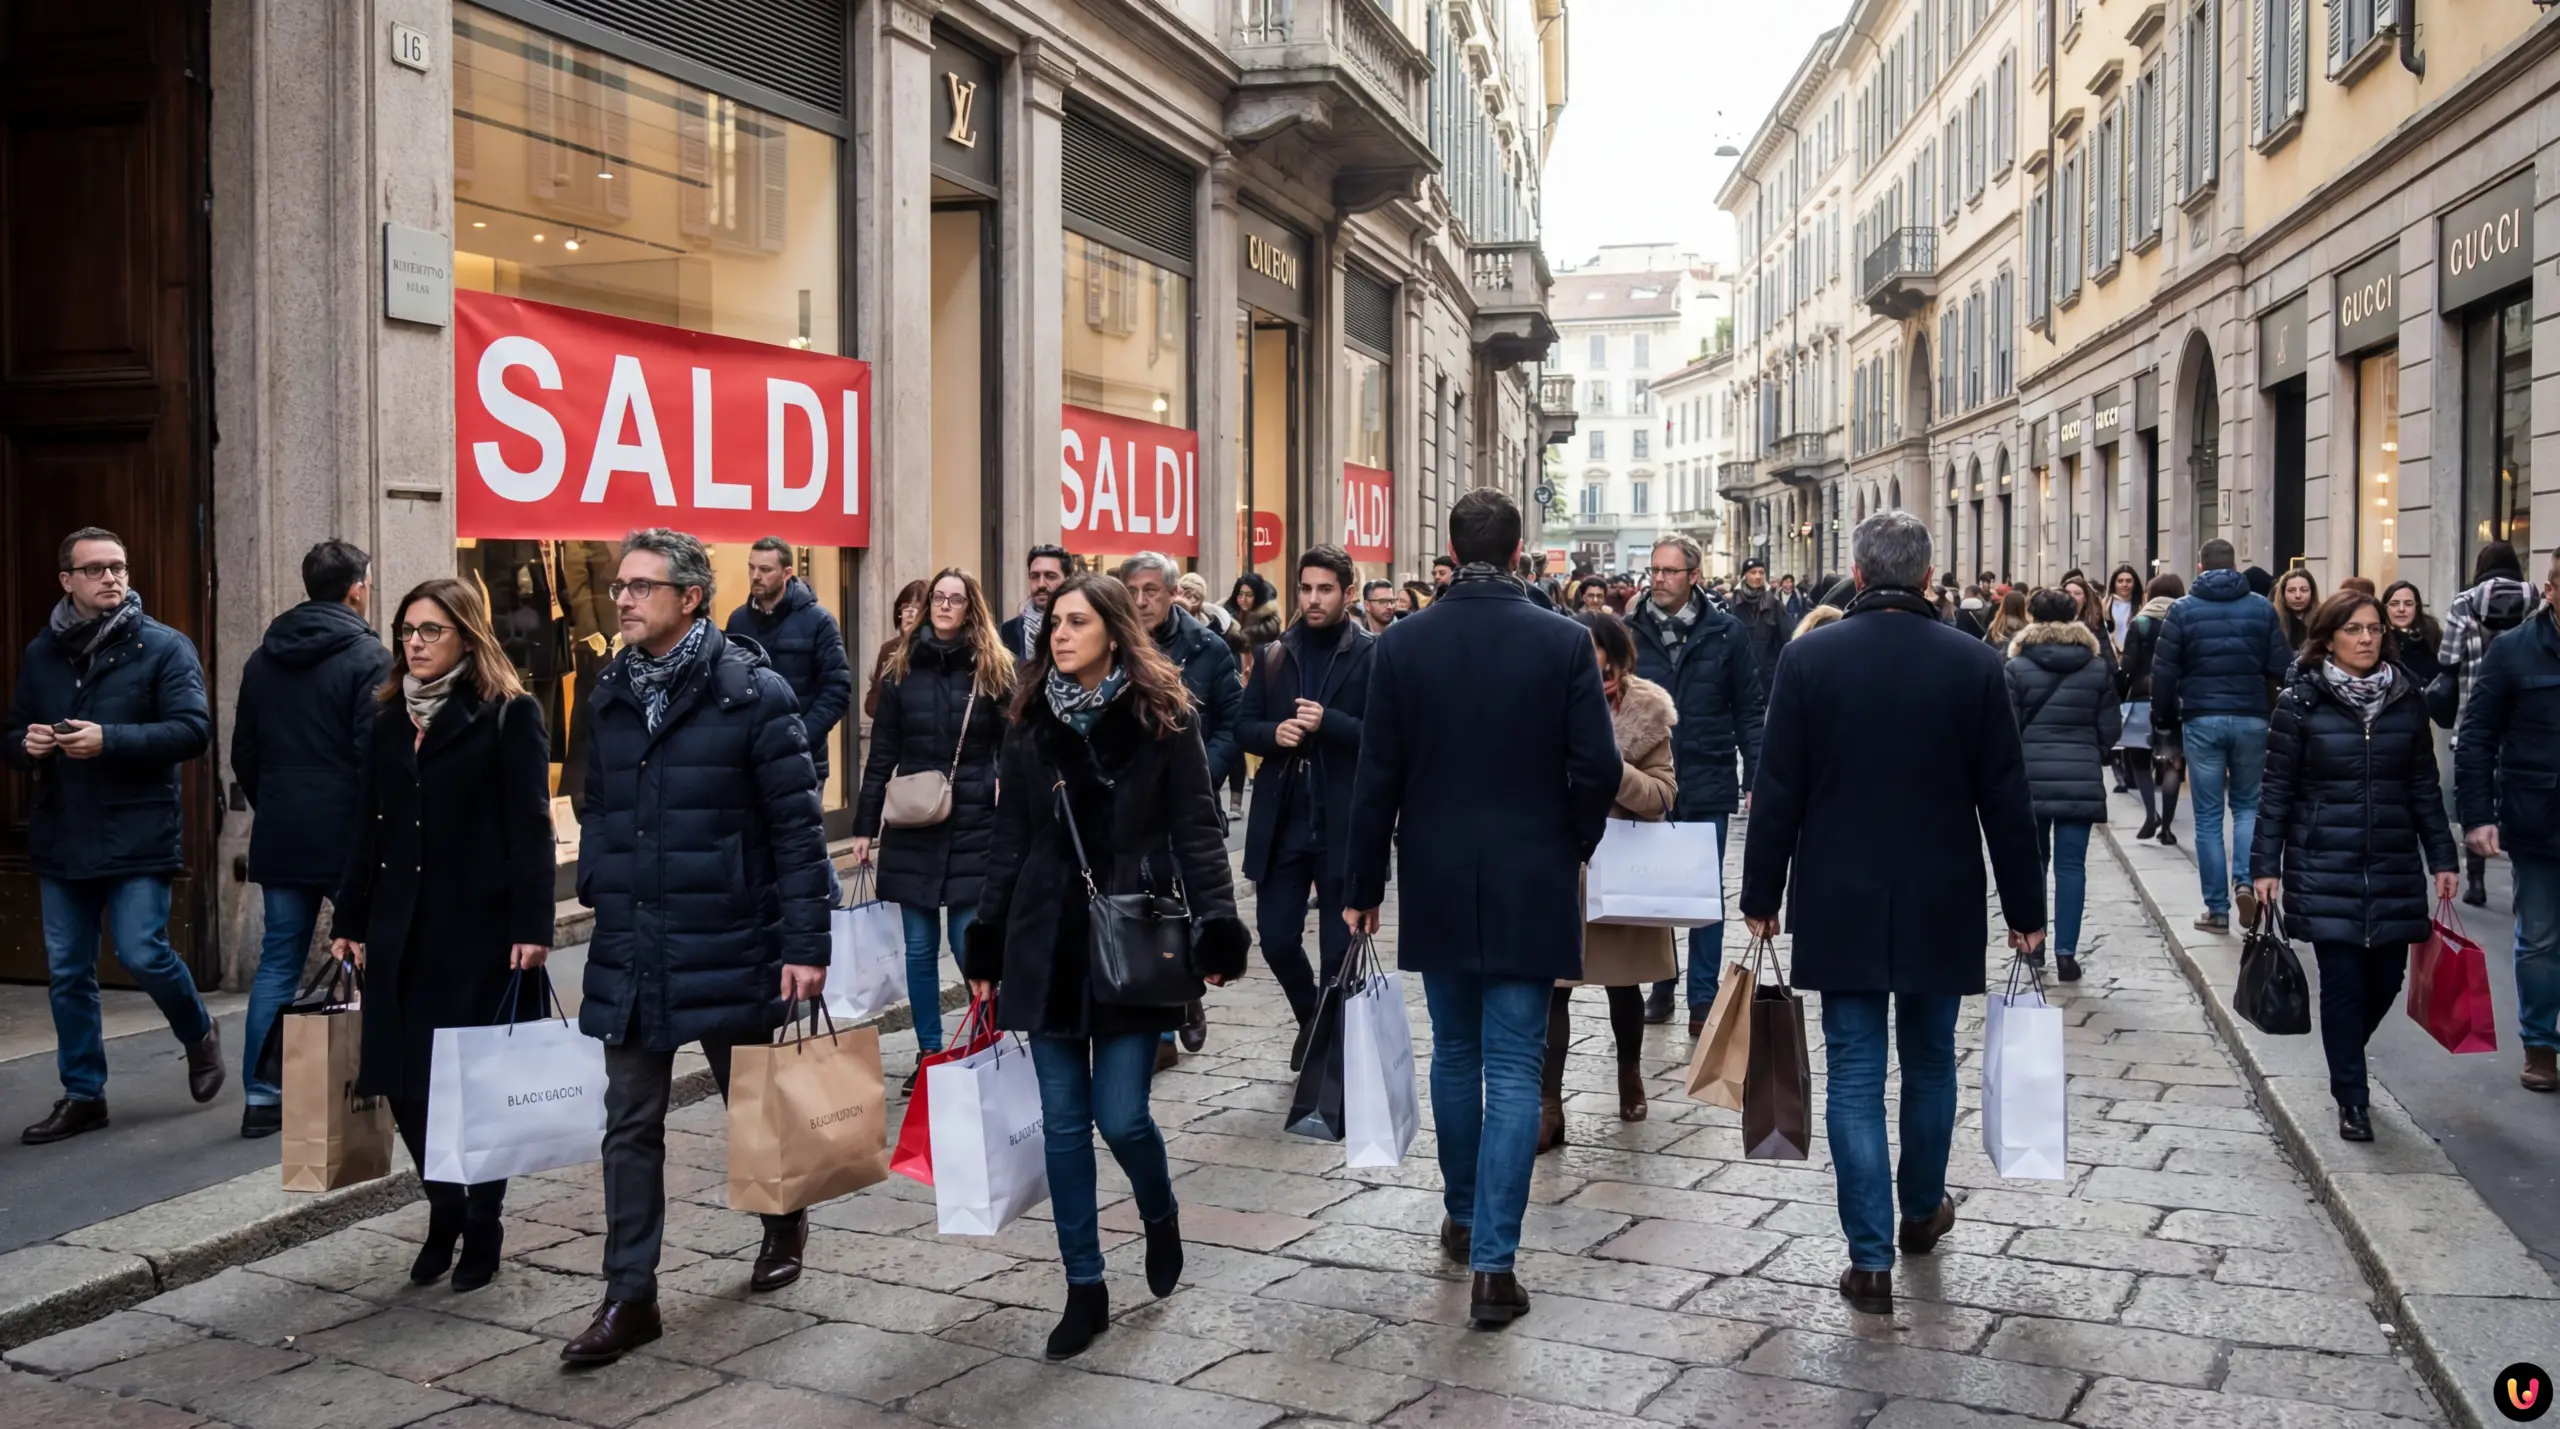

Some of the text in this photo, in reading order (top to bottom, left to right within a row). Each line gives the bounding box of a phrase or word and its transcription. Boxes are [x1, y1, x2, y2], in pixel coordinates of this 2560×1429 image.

[403, 32, 422, 62] 16
[2450, 208, 2520, 276] GUCCI
[2342, 274, 2392, 327] GUCCI
[472, 335, 859, 516] SALDI
[1061, 428, 1194, 537] SALDI
